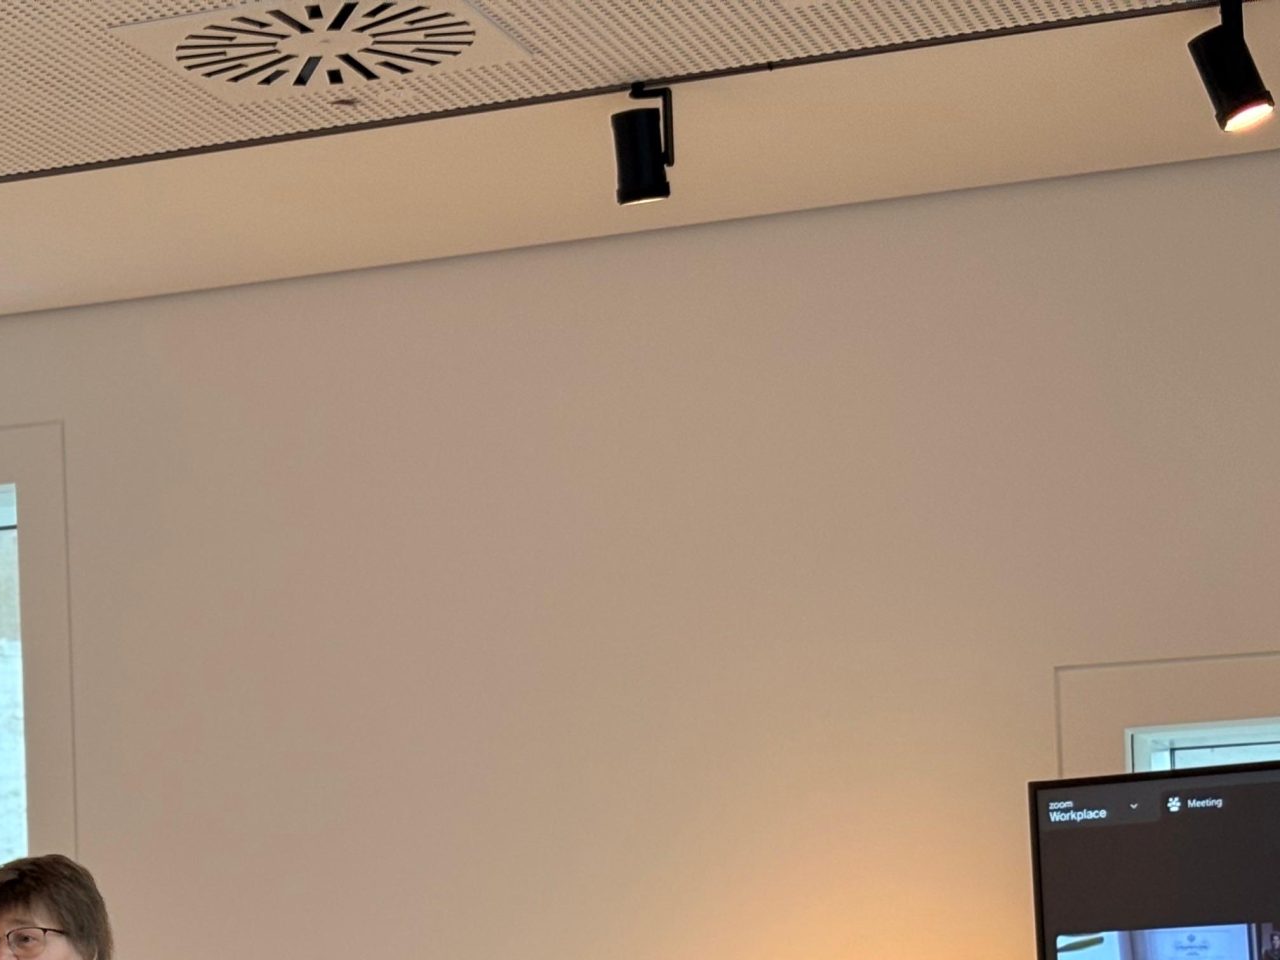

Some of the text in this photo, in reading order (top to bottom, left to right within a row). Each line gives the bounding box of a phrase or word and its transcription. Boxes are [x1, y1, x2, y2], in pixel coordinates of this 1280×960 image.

[1048, 800, 1073, 811] zoom
[1187, 797, 1223, 809] Meeting
[1049, 808, 1107, 823] Workplace
